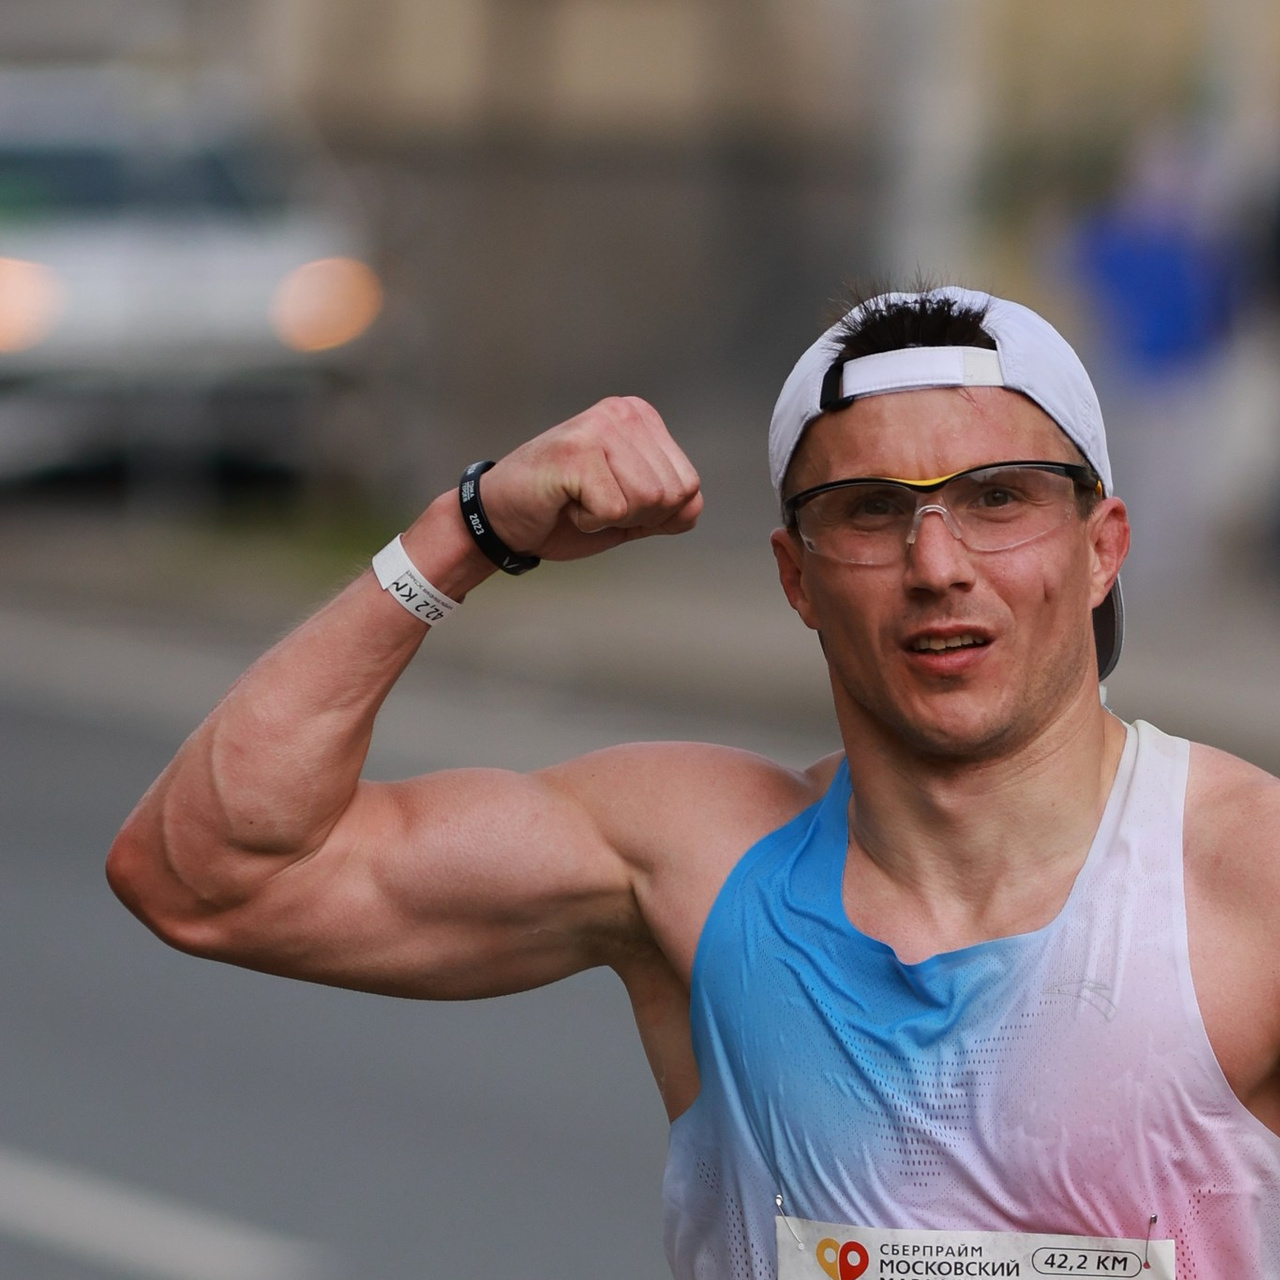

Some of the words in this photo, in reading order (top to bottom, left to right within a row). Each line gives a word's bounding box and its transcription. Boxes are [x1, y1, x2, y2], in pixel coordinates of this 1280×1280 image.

[469, 513, 485, 536] 2023
[414, 600, 444, 621] 42,2
[880, 1243, 984, 1258] СБЕРПРАЙМ
[879, 1258, 1021, 1279] МОСКОВСКИЙ
[1044, 1253, 1088, 1271] 42,2
